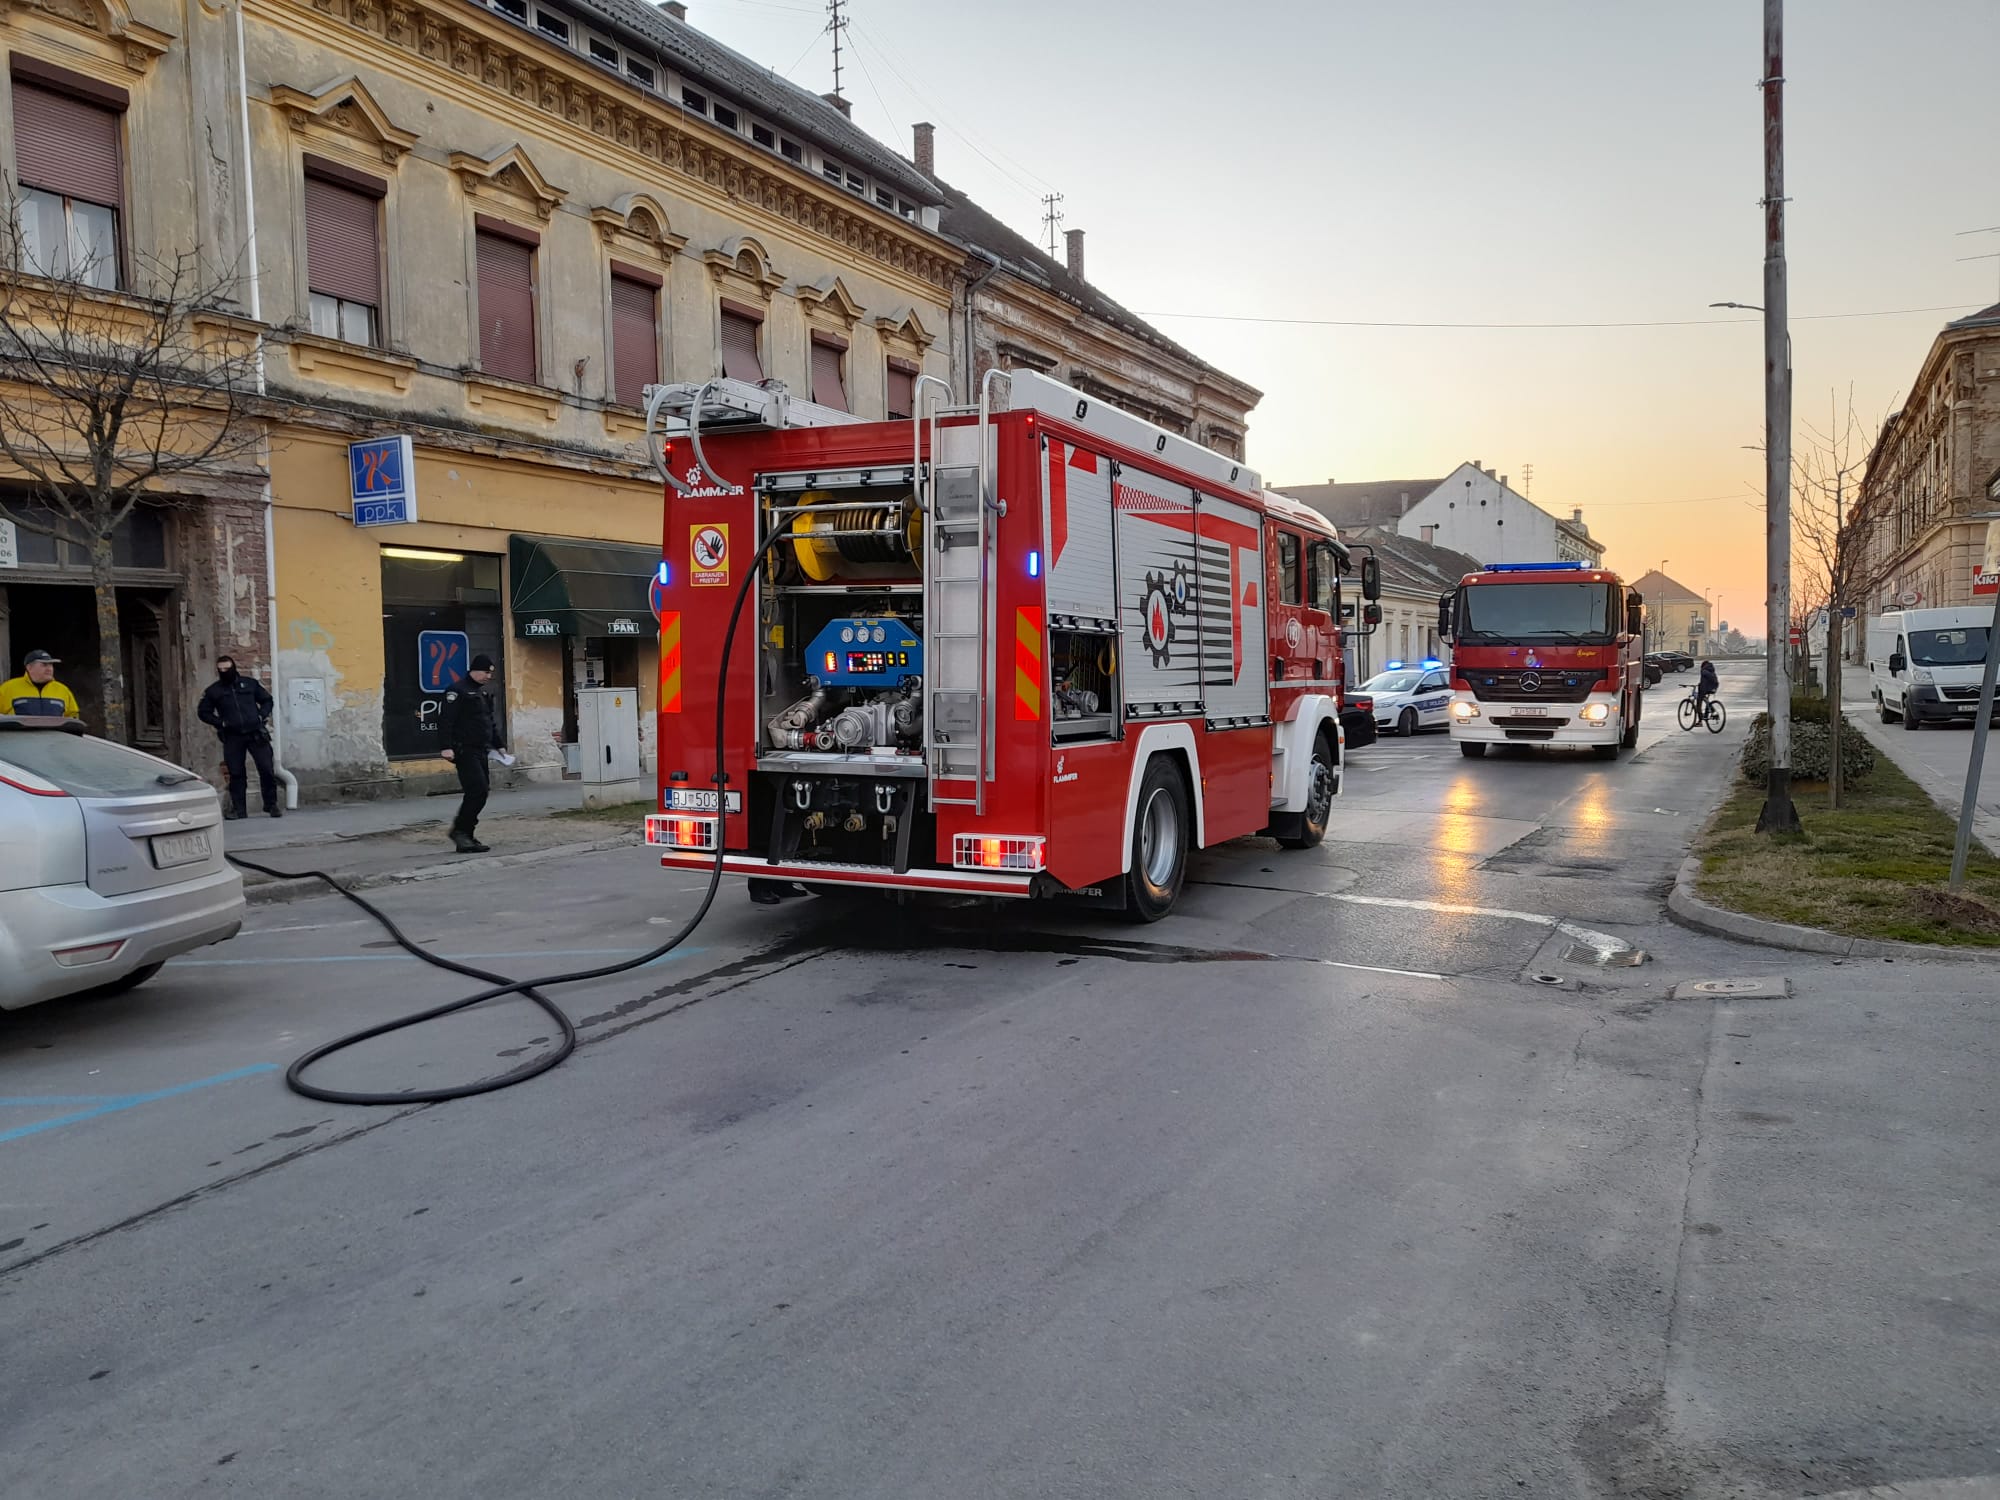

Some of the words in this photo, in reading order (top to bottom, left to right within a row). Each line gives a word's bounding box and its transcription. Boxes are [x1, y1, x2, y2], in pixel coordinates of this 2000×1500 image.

[530, 625, 554, 634] PAN
[613, 624, 635, 633] PAN
[673, 791, 687, 806] BJ
